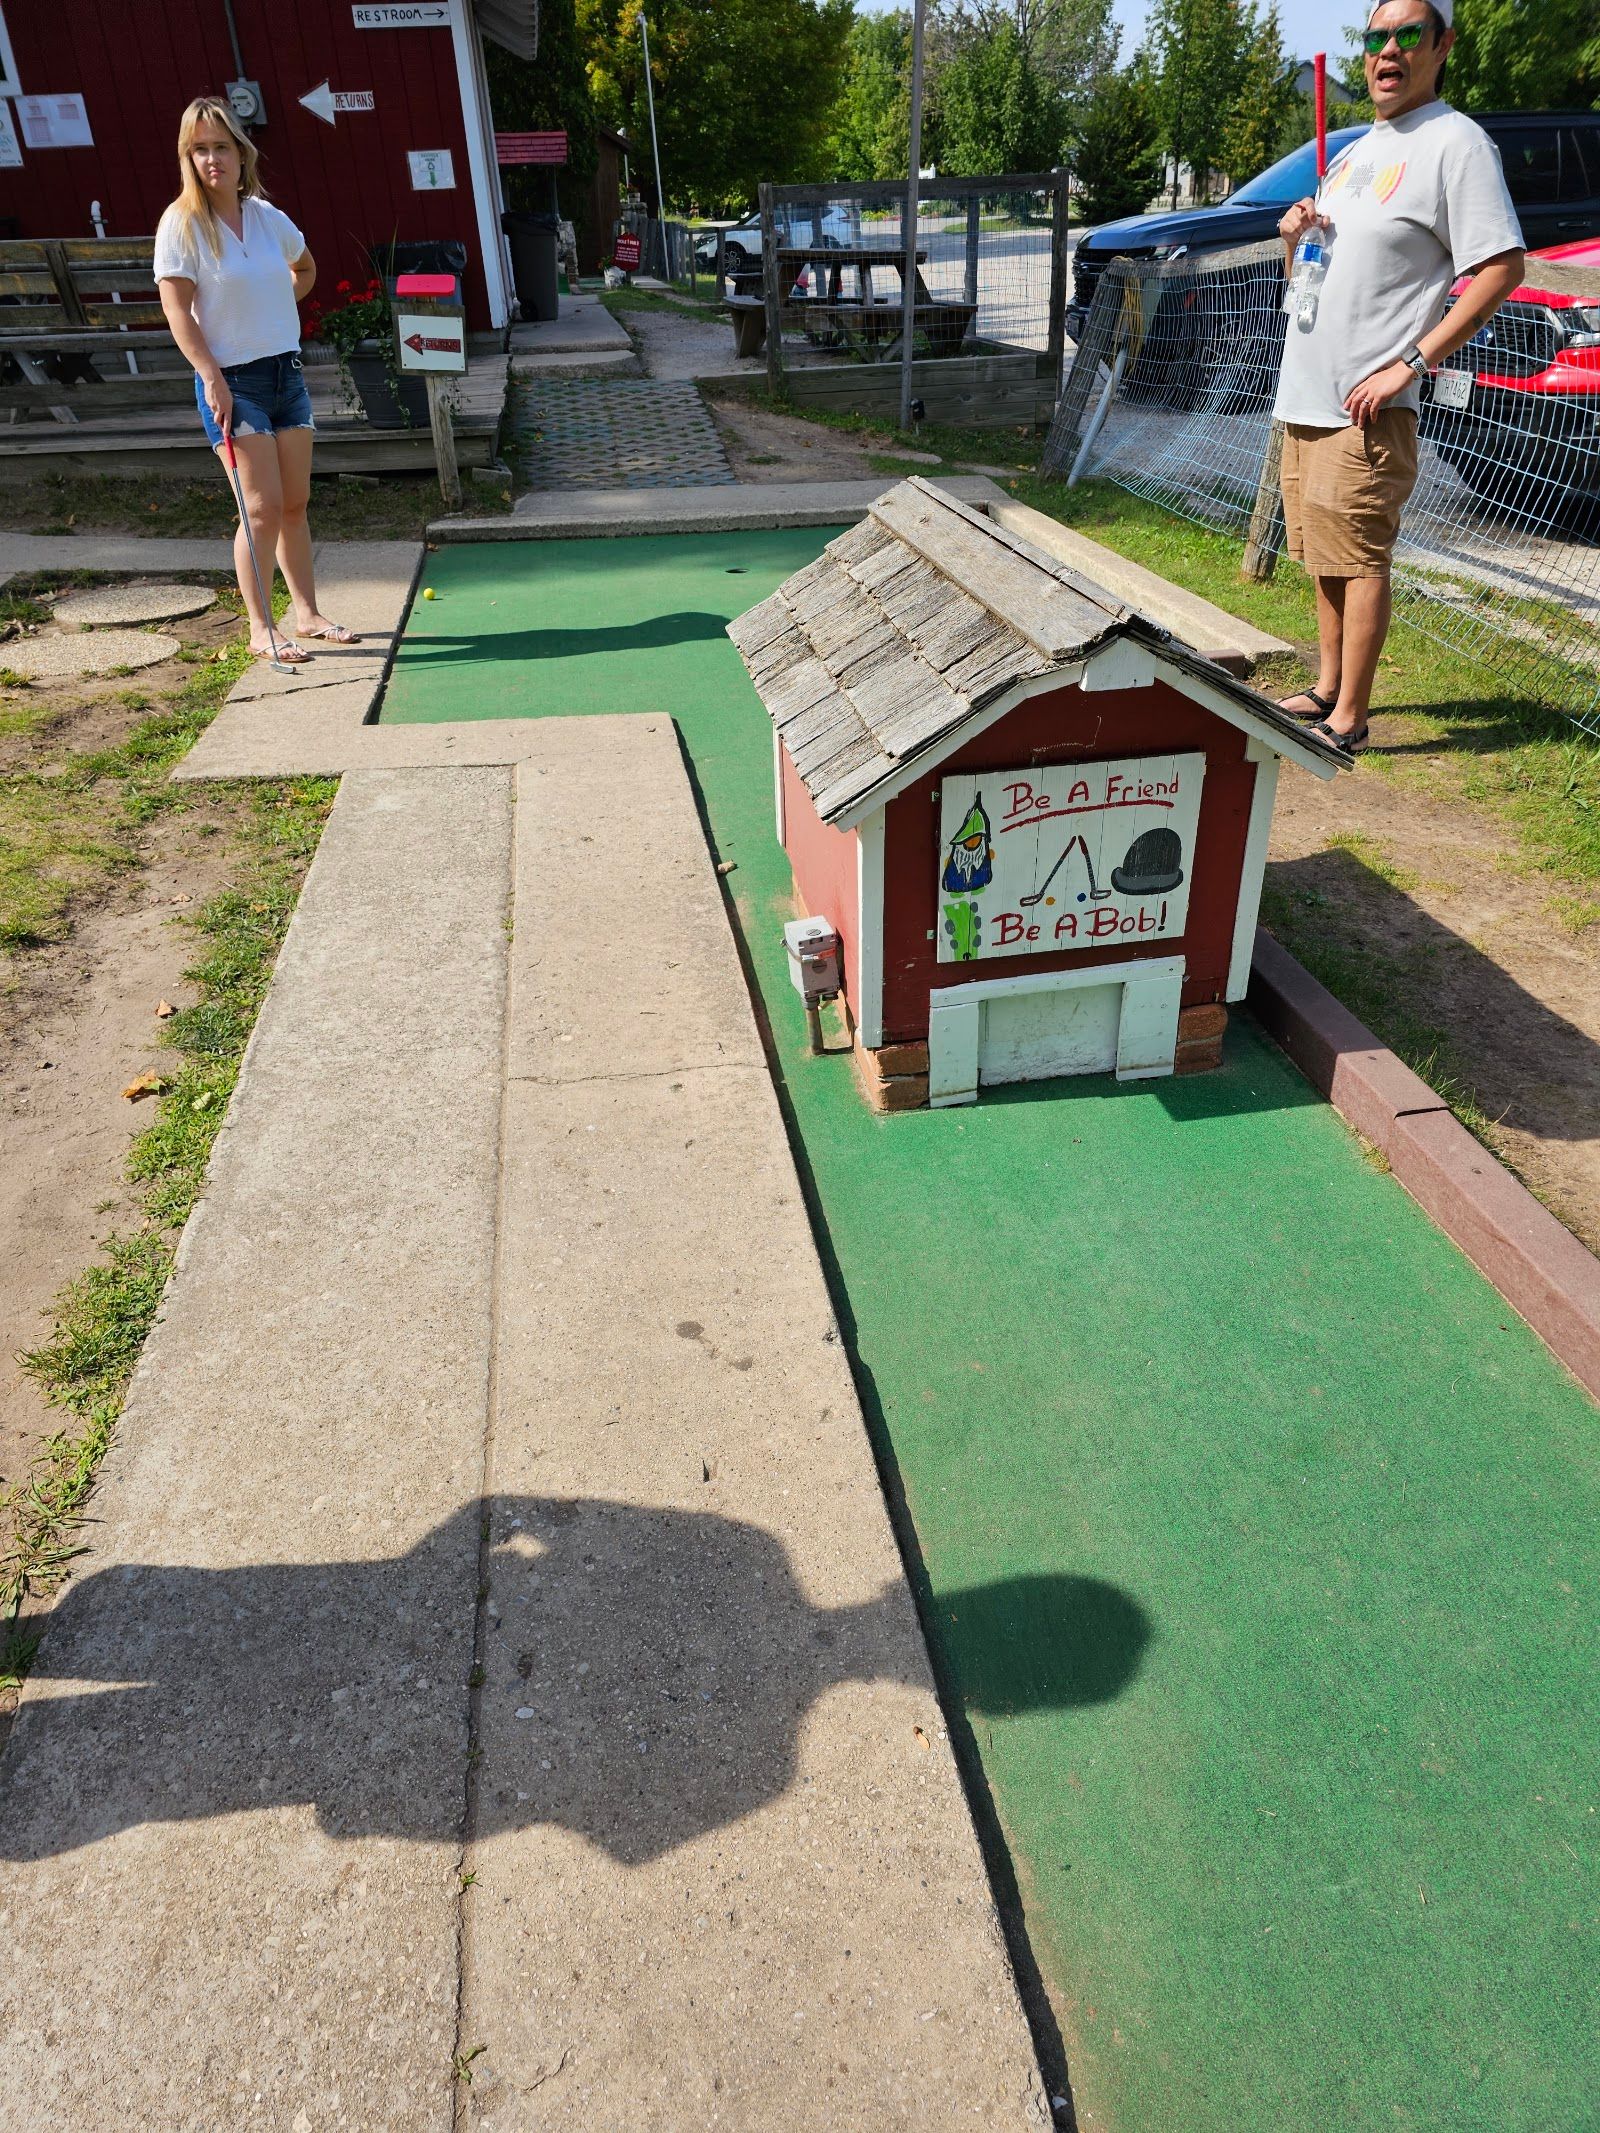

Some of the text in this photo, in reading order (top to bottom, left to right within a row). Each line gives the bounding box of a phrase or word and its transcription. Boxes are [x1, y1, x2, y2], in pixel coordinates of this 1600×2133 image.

[357, 8, 423, 22] RESTROOM
[335, 93, 374, 109] RETURNS
[1002, 772, 1179, 819] Be A Friend
[991, 901, 1167, 946] Be A Bob!
